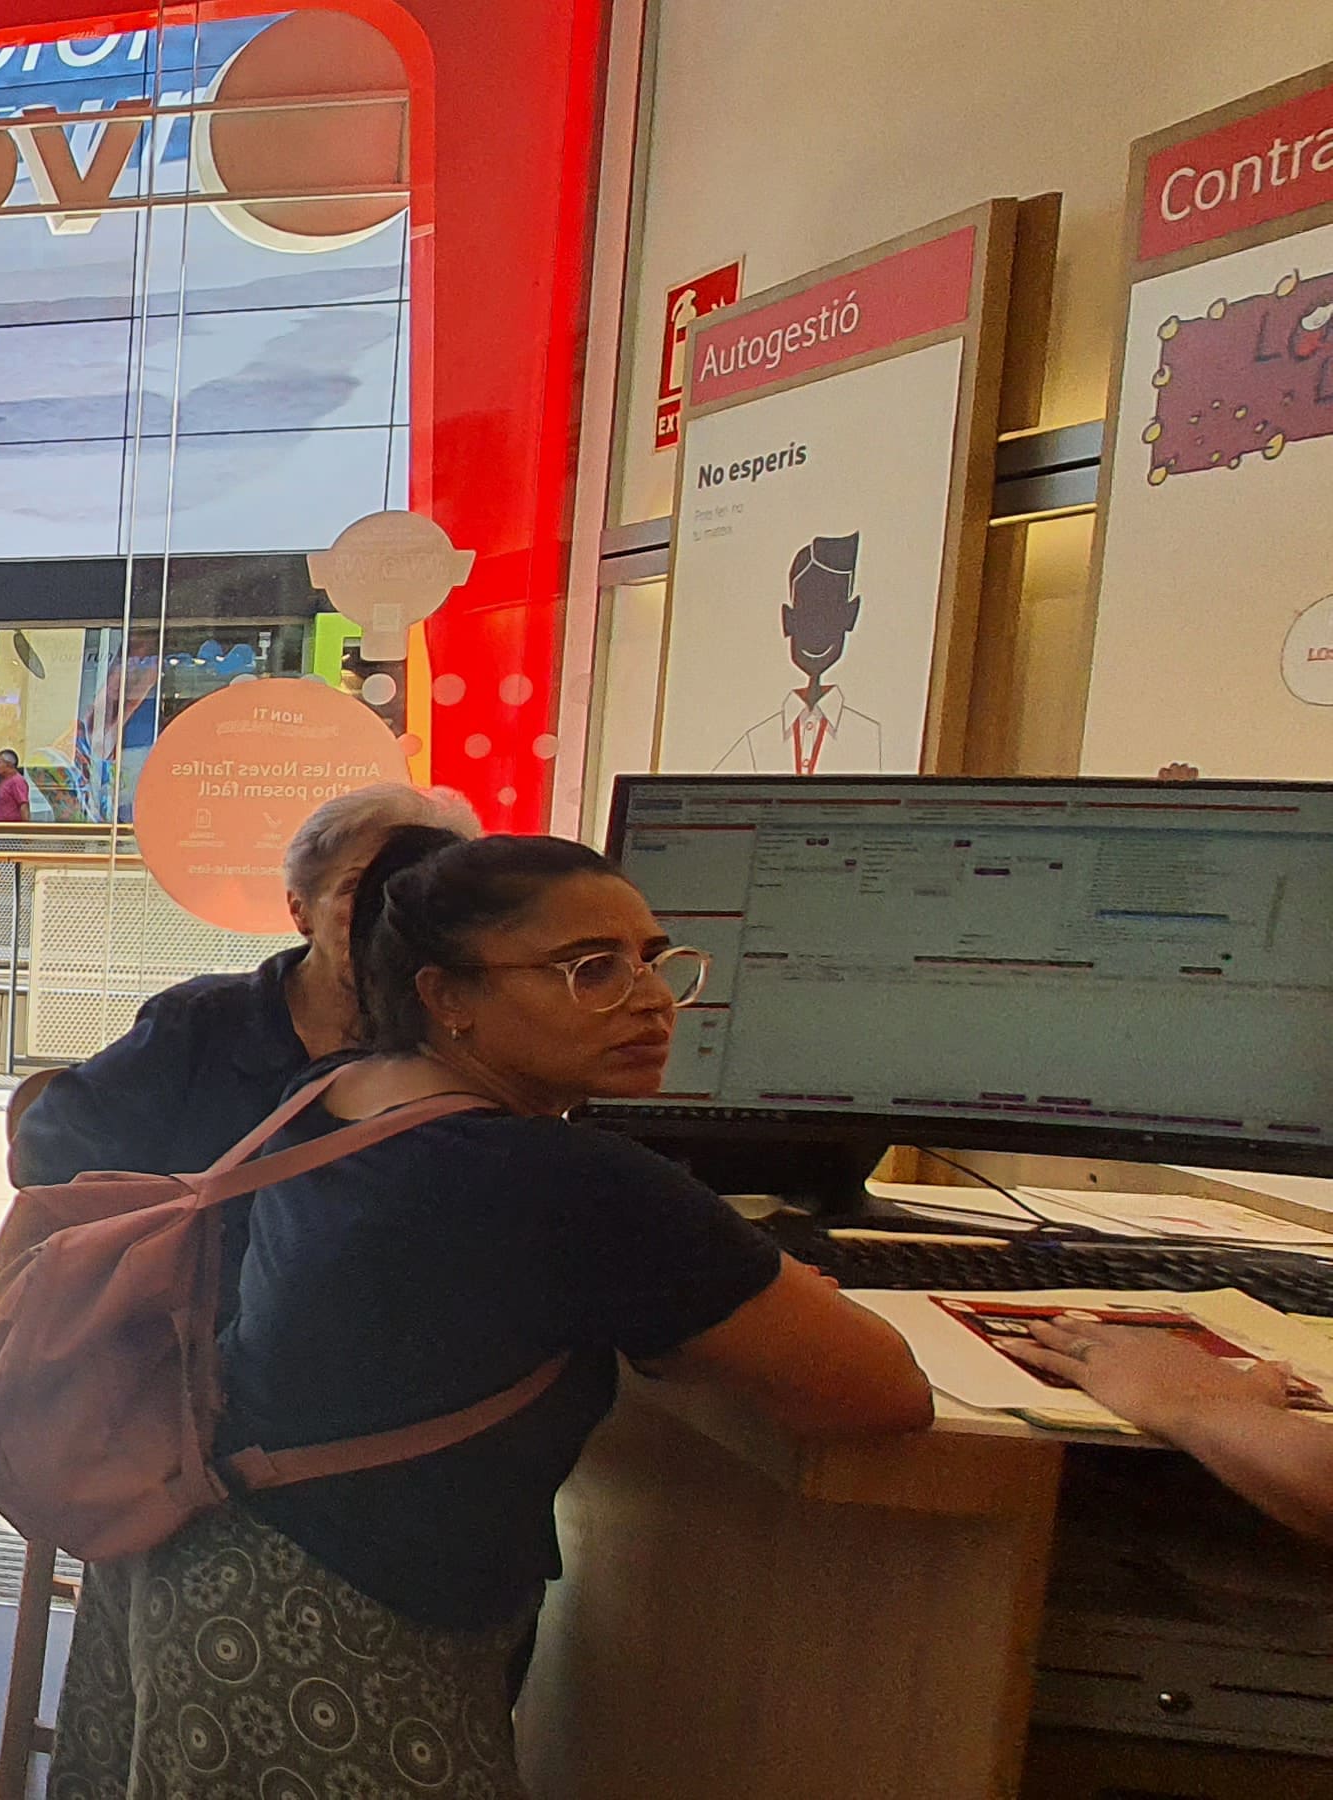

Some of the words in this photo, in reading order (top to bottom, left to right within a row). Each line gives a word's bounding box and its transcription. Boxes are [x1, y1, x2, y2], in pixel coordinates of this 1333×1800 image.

[699, 289, 860, 383] Autogestió
[697, 463, 725, 489] No
[729, 441, 807, 482] esperis
